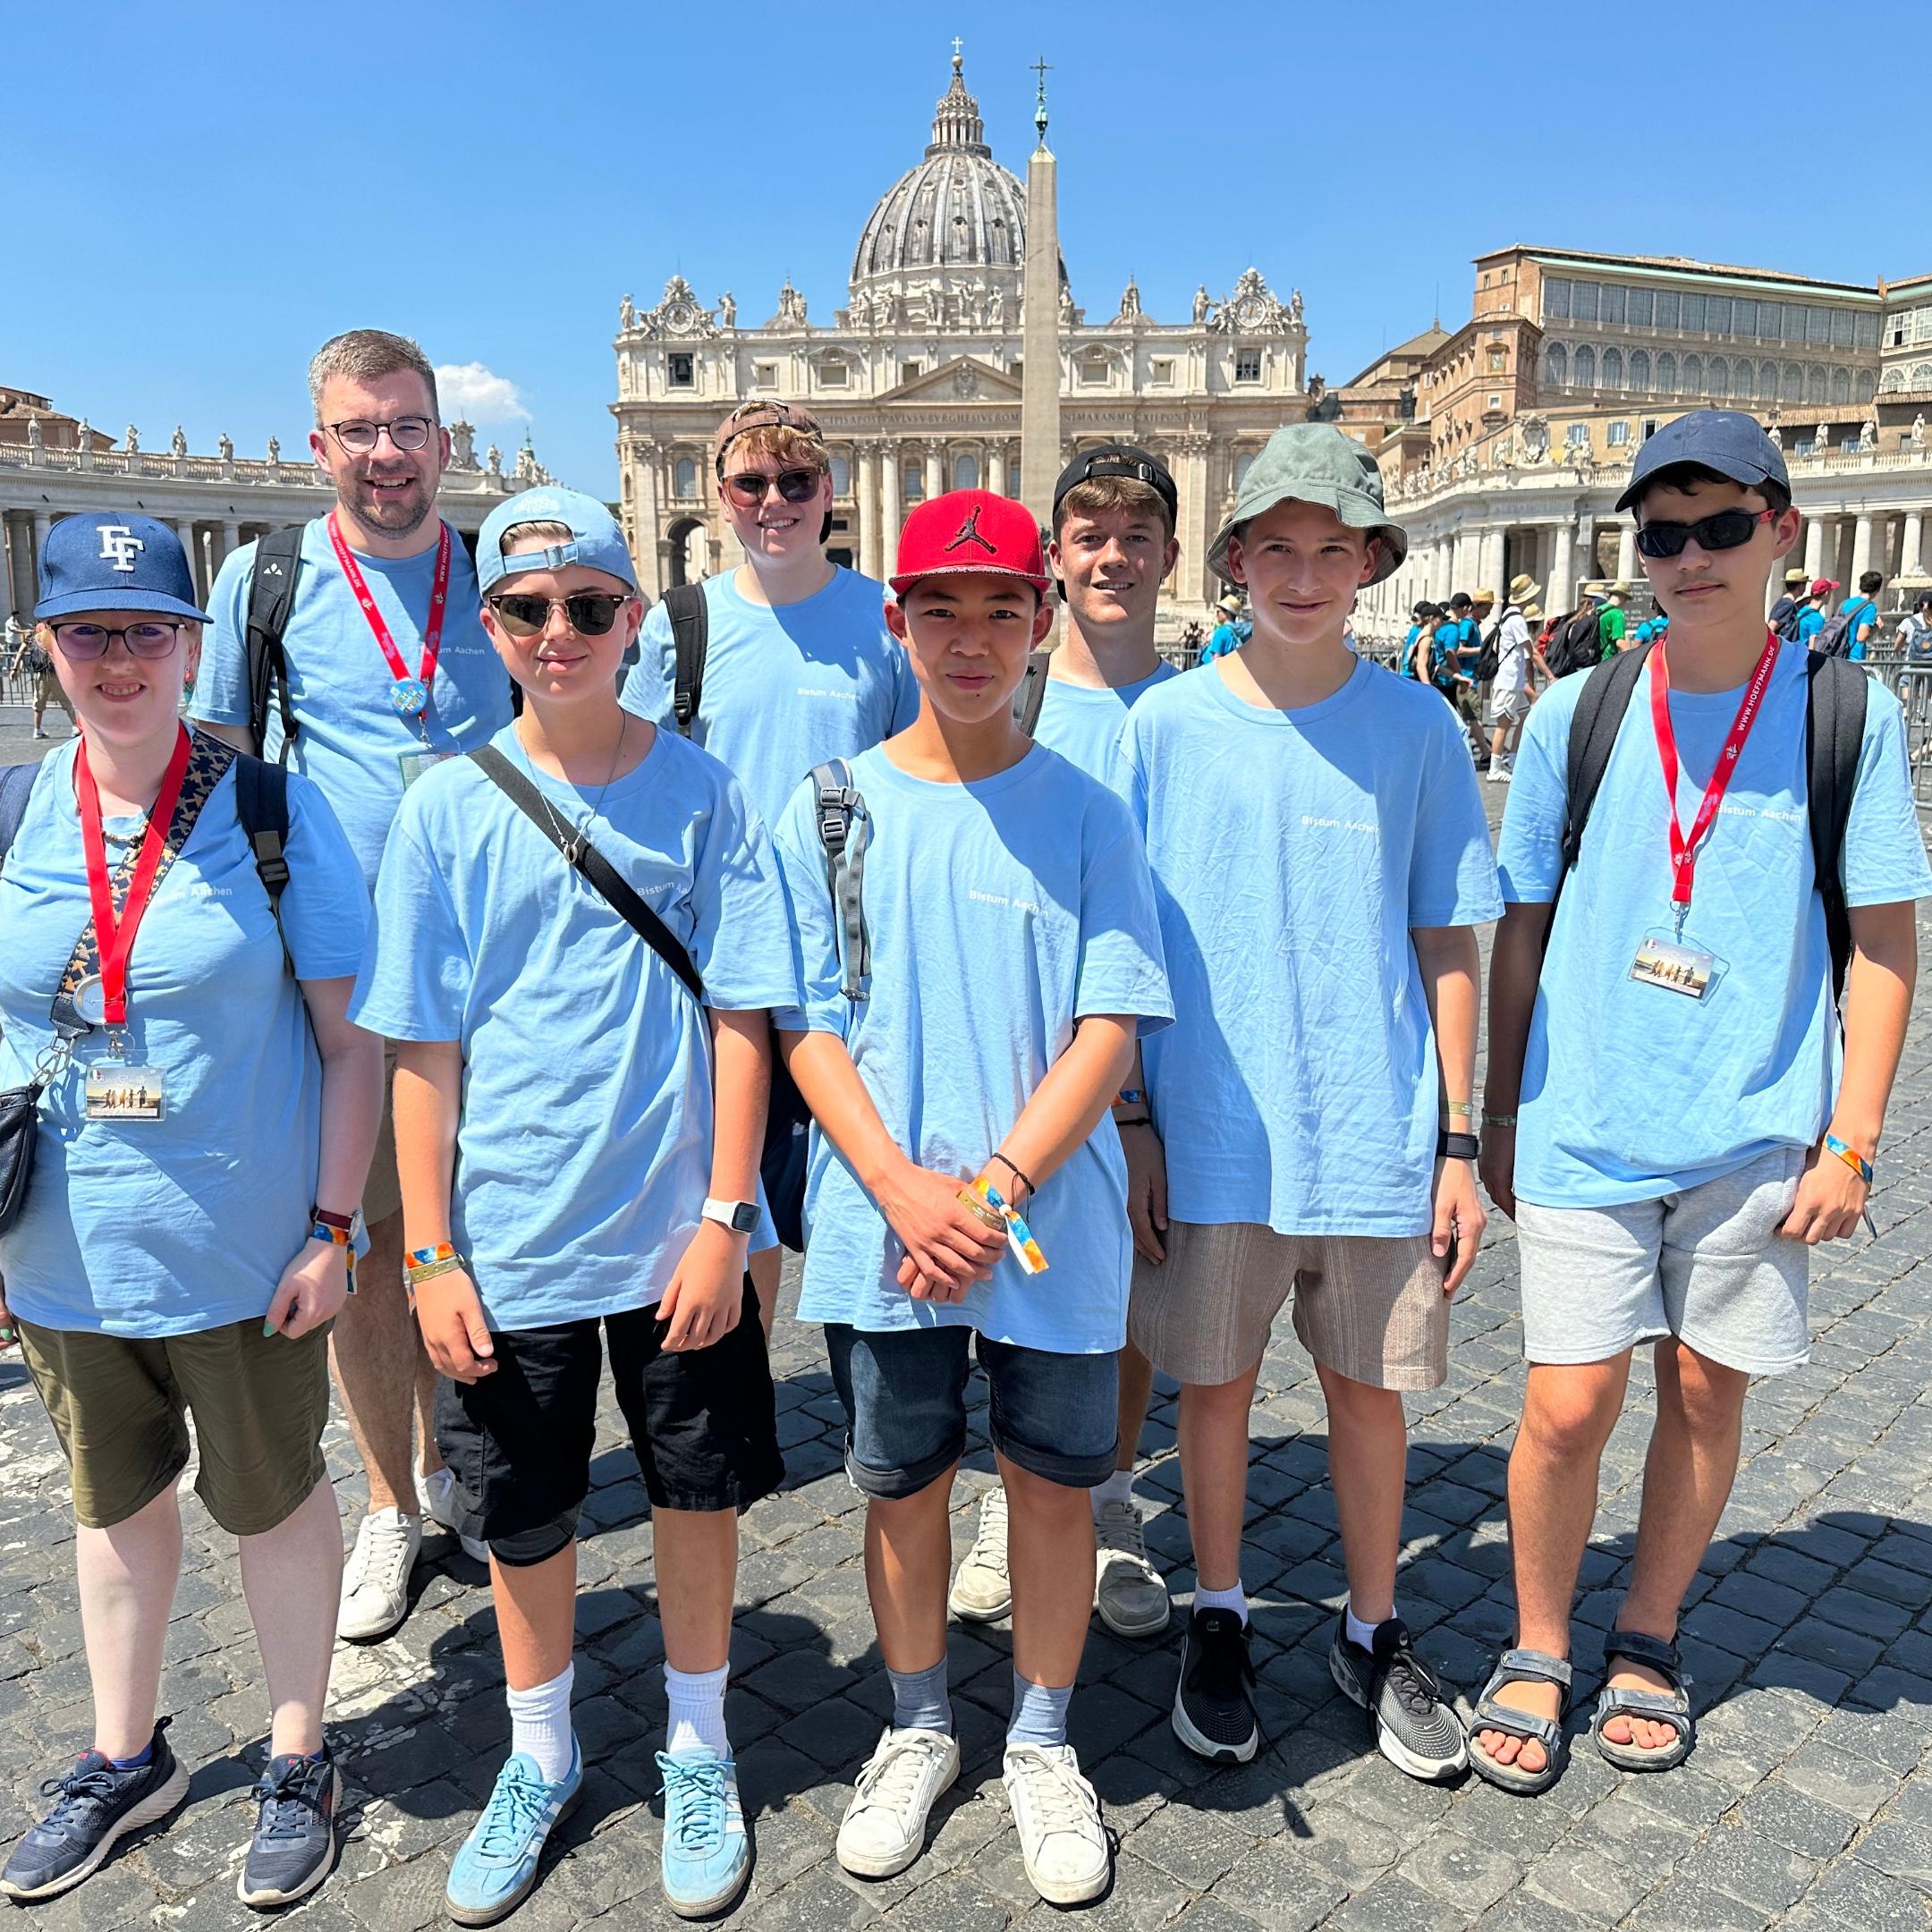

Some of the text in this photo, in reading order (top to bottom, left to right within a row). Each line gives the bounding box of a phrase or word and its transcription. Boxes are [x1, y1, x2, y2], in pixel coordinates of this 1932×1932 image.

[454, 646, 485, 655] Aachen
[1737, 646, 1775, 731] WWW.HOEFFMANN.DE
[1301, 815, 1340, 828] Bistum
[1760, 809, 1801, 822] Aachen
[636, 881, 675, 895] Bistum
[969, 889, 1008, 906] Bistum
